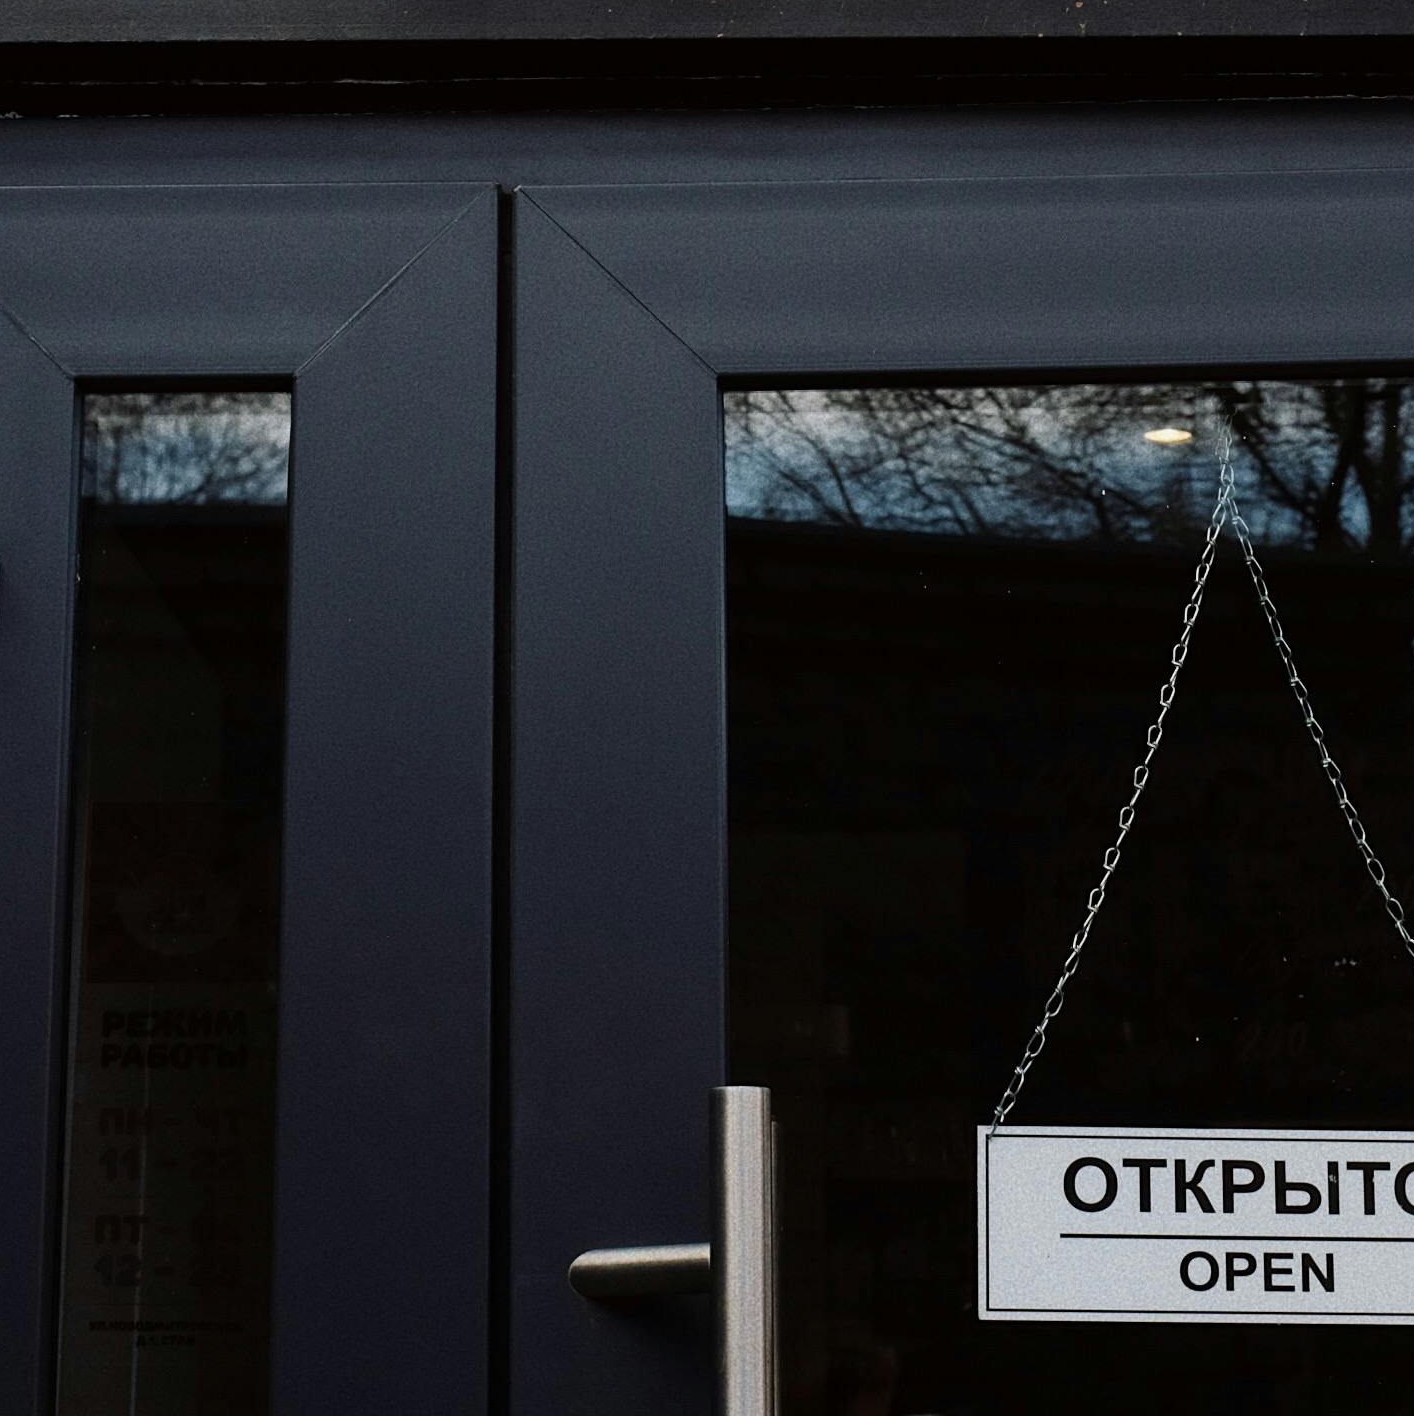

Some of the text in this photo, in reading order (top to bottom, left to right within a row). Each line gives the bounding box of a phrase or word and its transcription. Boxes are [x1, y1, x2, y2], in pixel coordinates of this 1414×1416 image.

[101, 1009, 248, 1038] РЕЖИМ
[99, 1042, 249, 1070] РАБОТЫ
[1179, 1250, 1336, 1293] OPEN
